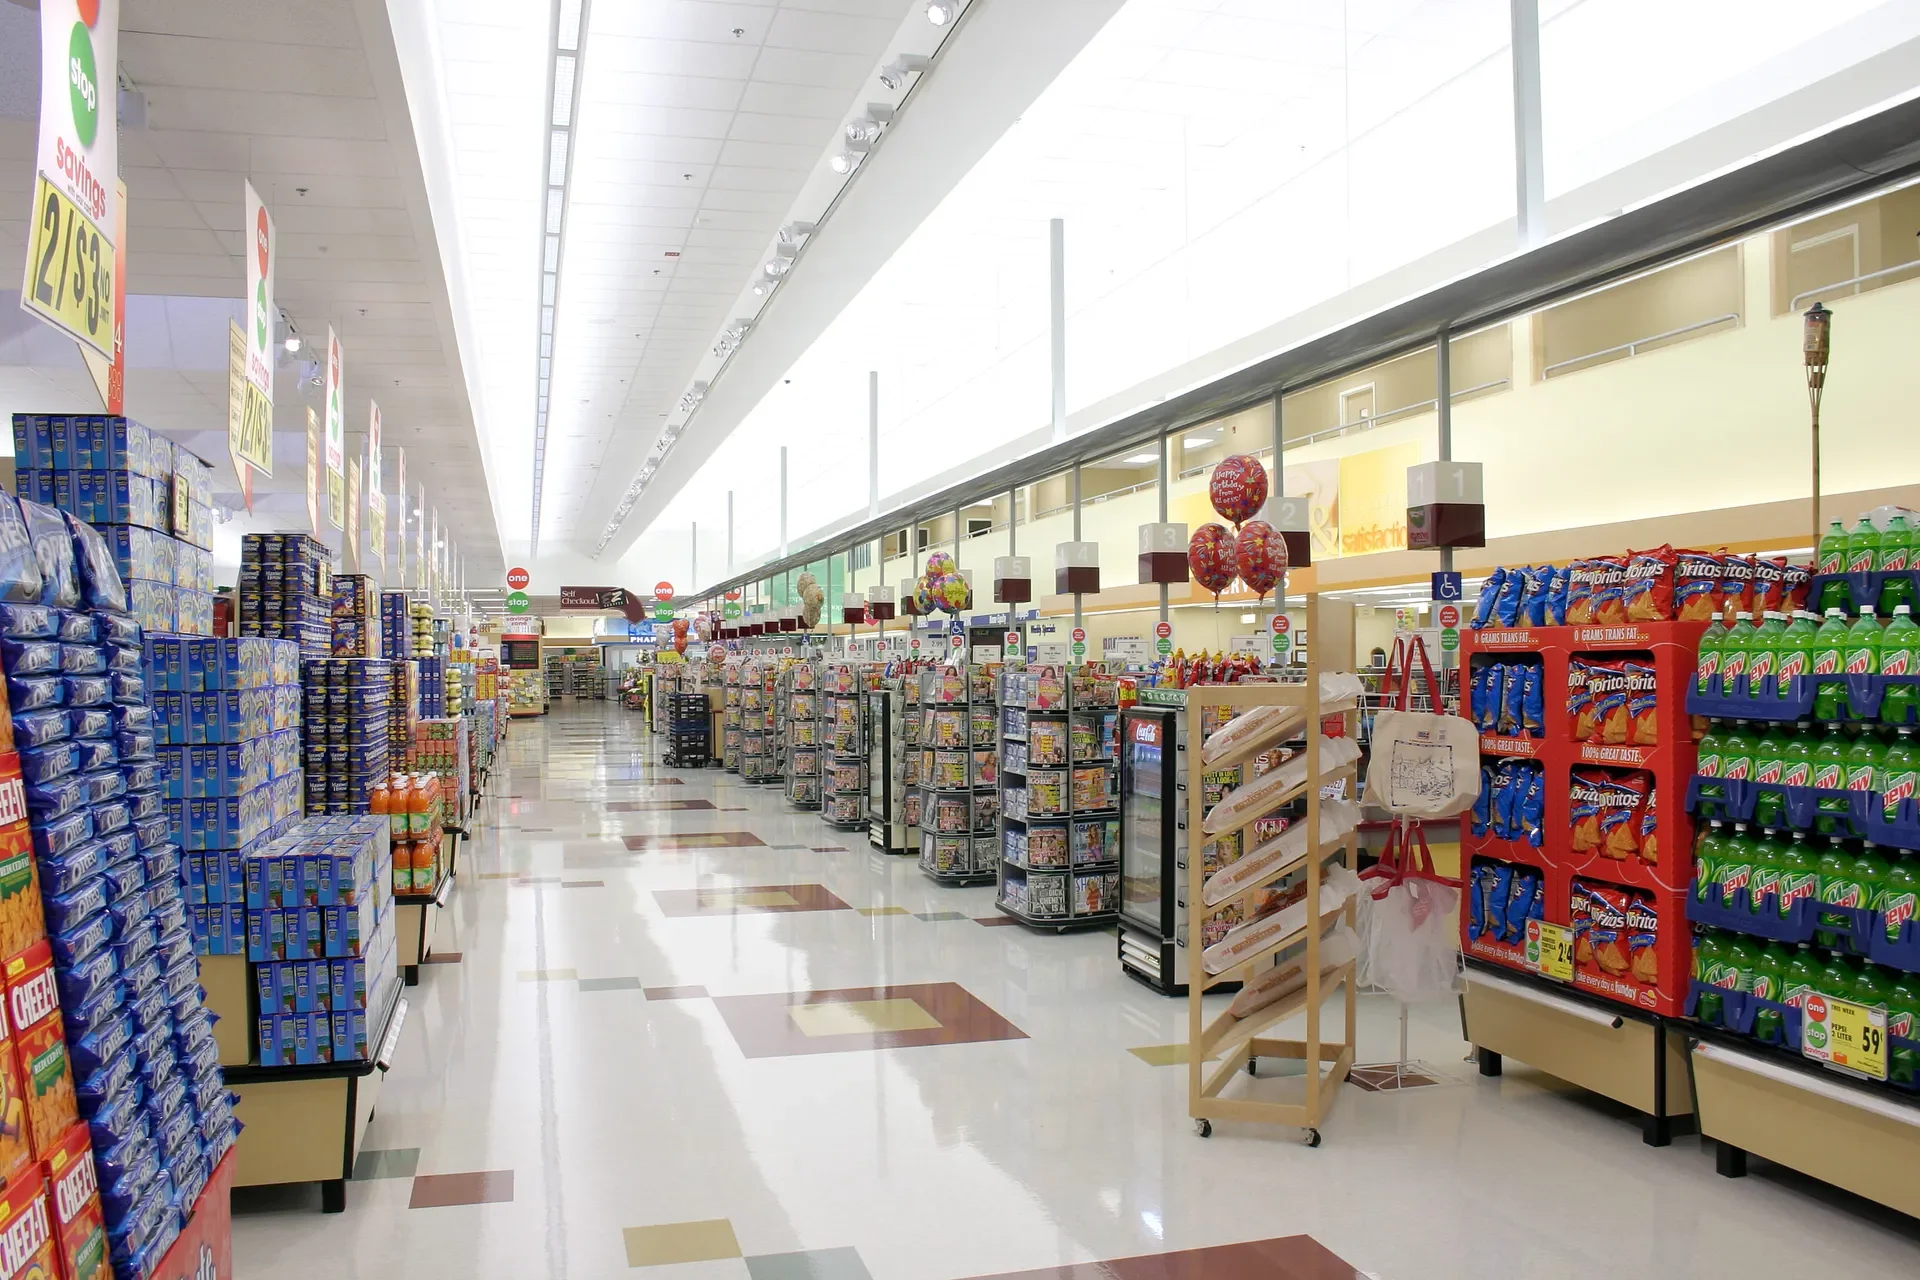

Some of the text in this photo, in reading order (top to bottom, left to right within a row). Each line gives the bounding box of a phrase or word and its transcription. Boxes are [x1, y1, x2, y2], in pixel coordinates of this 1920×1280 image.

[70, 57, 96, 112] stop
[57, 136, 106, 221] savings
[1216, 468, 1240, 480] Happy
[1212, 480, 1244, 492] Birthday
[1453, 469, 1464, 497] 1
[1282, 502, 1296, 526] 2
[1164, 527, 1176, 548] 3
[1342, 520, 1407, 554] satisfactio
[1078, 547, 1089, 562] 4
[1013, 560, 1023, 575] 5
[508, 574, 528, 582] one
[562, 590, 576, 598] Self
[881, 589, 889, 600] 8
[508, 598, 528, 607] stop
[655, 608, 673, 616] stop
[1474, 633, 1479, 644] 0
[1480, 632, 1499, 644] GRAMS
[1500, 632, 1518, 643] TRANS
[1574, 630, 1579, 641] 0
[1581, 629, 1603, 641] GRAMS
[1604, 629, 1625, 640] TRANS
[1481, 738, 1496, 751] 100%
[1497, 739, 1513, 751] GREAT
[1582, 746, 1642, 763] 100% GREAT TASTE.
[1255, 820, 1288, 834] OGUE
[1496, 947, 1505, 959] day
[1577, 971, 1587, 984] ake
[1587, 976, 1600, 988] every
[1601, 979, 1610, 992] day
[1615, 980, 1637, 1001] funday
[12, 966, 60, 1031] CHEEZ-IT
[1808, 1003, 1825, 1014] one
[1831, 1004, 1840, 1012] THIS
[1806, 1027, 1826, 1041] stop
[1837, 1031, 1852, 1042] LITER
[1804, 1046, 1829, 1058] savings
[56, 1149, 98, 1225] CHEEZ-IT
